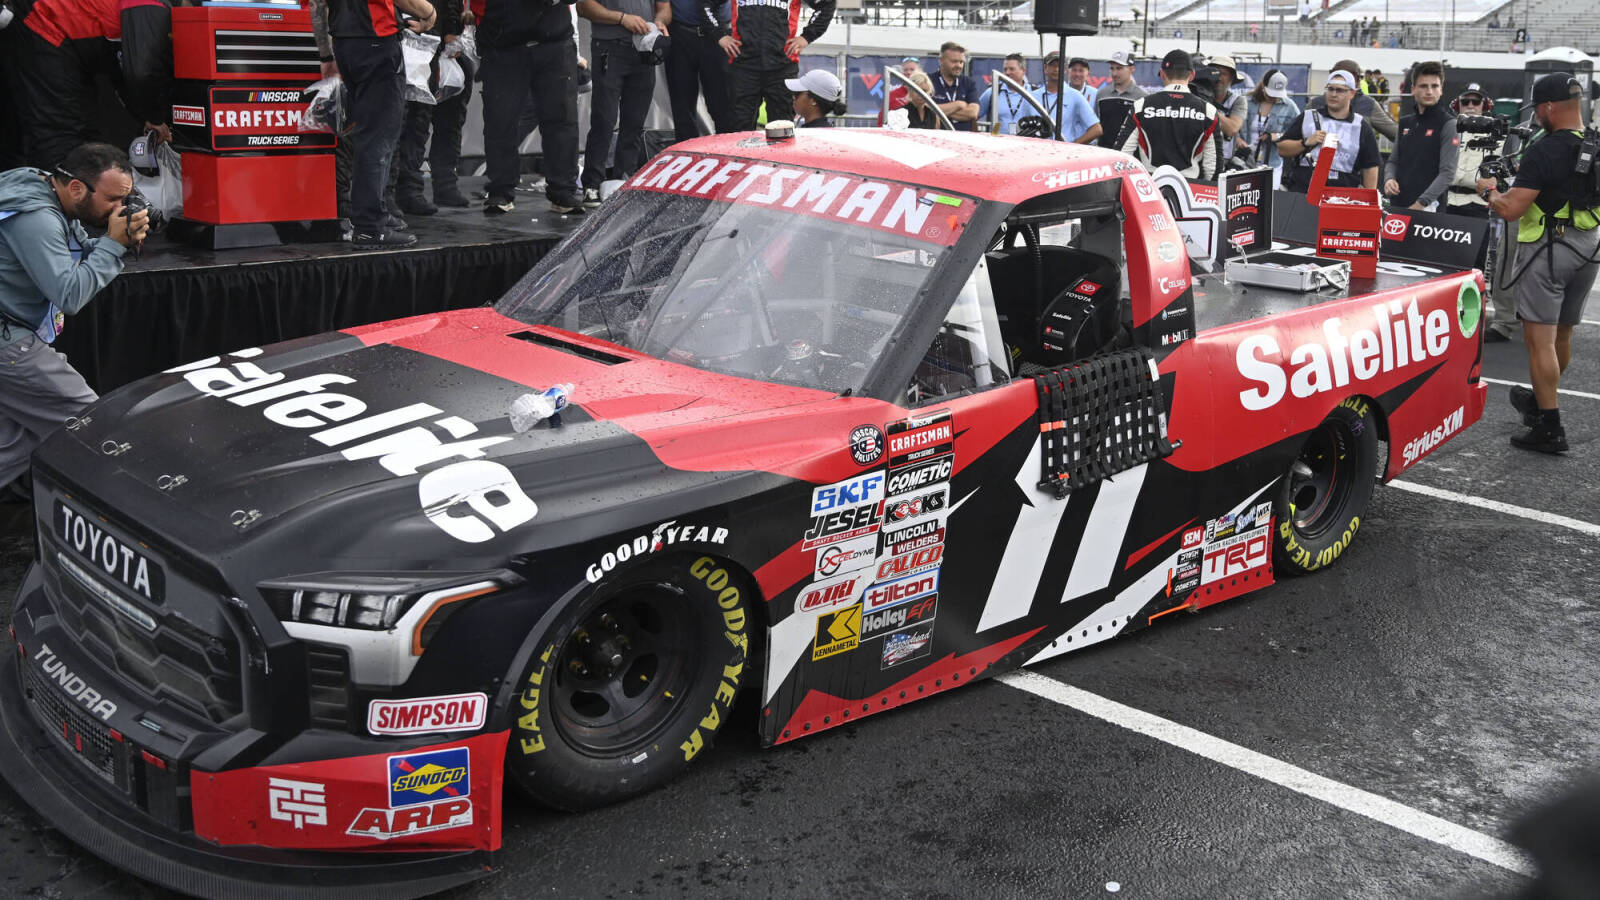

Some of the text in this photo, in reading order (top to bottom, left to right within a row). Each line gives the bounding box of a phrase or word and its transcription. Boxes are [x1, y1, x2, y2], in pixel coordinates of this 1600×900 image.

[261, 91, 300, 102] NASCAR
[174, 109, 204, 121] CRAFTSMAN
[214, 110, 302, 127] CRAFTSM
[1144, 106, 1206, 120] Safelite
[248, 136, 299, 145] TRUCK SERIES
[1045, 165, 1113, 189] HEIM
[631, 154, 940, 235] CRAFTSMAN
[1227, 193, 1242, 212] THE
[1242, 190, 1260, 206] TRIP
[1322, 238, 1373, 248] CRAFTSMAN
[1413, 224, 1472, 244] TOYOTA
[1065, 291, 1091, 302] TOYOTA
[1162, 331, 1181, 346] Mobil
[1236, 295, 1450, 411] Safelite
[852, 428, 878, 443] NASCAR
[890, 426, 950, 452] CRAFTSMAN
[1402, 405, 1464, 467] SiriusXM
[854, 447, 881, 462] SALUTES
[888, 460, 951, 493] COMETIC
[814, 475, 883, 512] SKF
[884, 489, 946, 526] KOOKS
[804, 501, 882, 541] JESEL
[887, 520, 937, 545] LINCOLN
[897, 534, 940, 553] WELDERS
[1184, 530, 1201, 546] SEM
[62, 504, 151, 599] TOYOTA
[585, 524, 729, 583] GOODYEAR
[877, 545, 945, 579] CALICO
[1204, 535, 1267, 576] TRD
[868, 577, 934, 607] tilton
[862, 608, 907, 634] Holley
[679, 556, 749, 761] GOODYEAR
[814, 638, 857, 658] KENNAMETAL
[34, 644, 117, 721] TUNDRA
[377, 699, 477, 729] SIMPSON
[396, 767, 464, 791] SUNOCO
[351, 799, 471, 834] ARP
